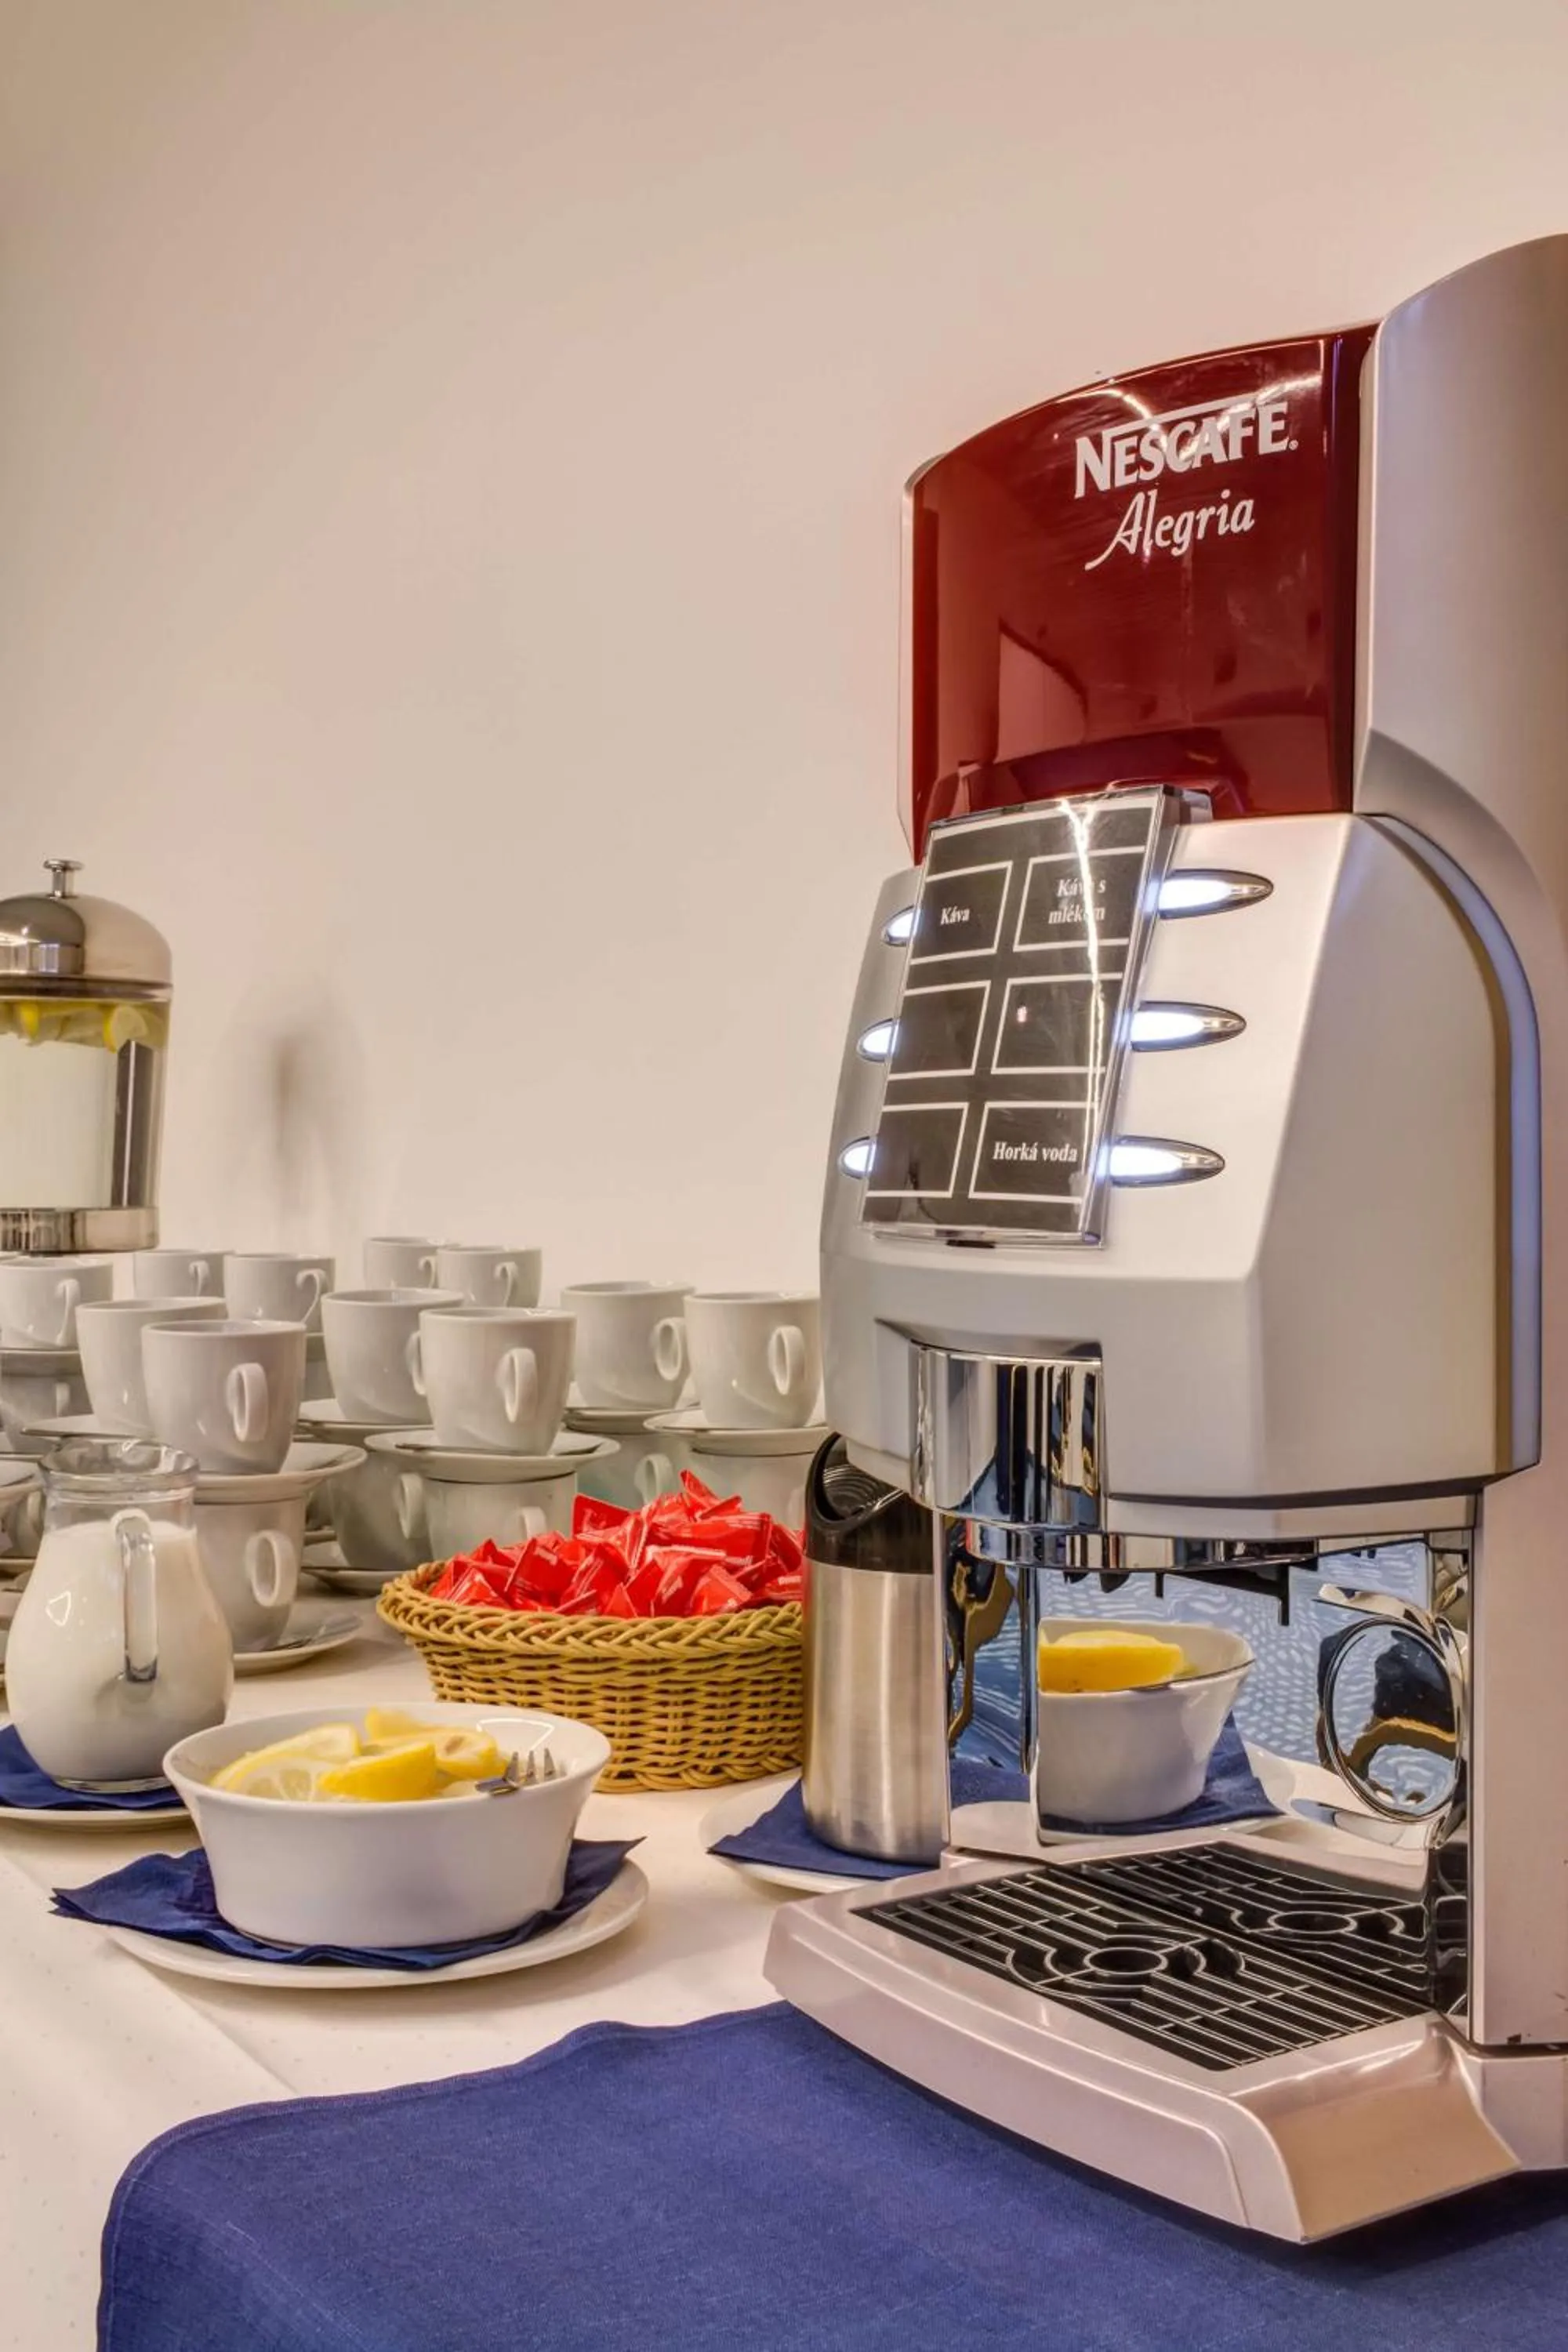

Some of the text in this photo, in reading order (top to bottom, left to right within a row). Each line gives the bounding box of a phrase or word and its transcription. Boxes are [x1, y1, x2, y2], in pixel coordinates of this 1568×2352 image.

[1085, 488, 1254, 571] Alegria
[1098, 879, 1106, 894] s
[941, 906, 970, 925] Káva
[991, 1142, 1078, 1162] Horká voda
